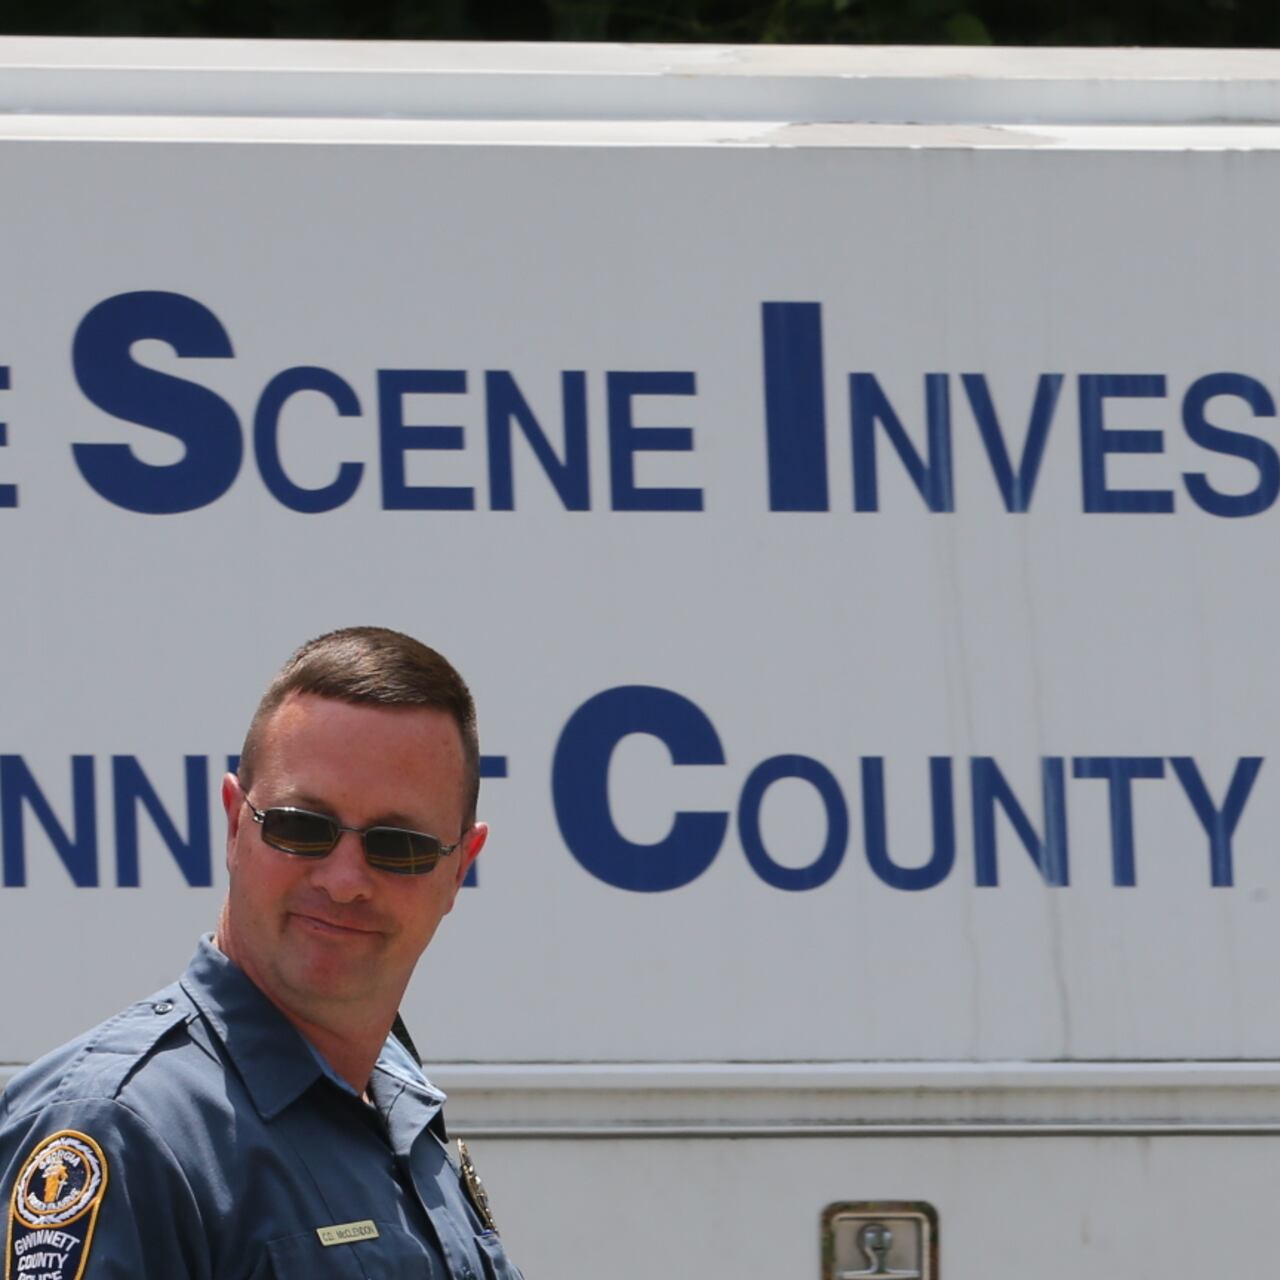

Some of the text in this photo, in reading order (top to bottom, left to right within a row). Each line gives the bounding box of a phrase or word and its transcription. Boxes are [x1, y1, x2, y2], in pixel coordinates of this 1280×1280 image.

[70, 290, 706, 515] SCENE
[550, 684, 1265, 893] COUNTY
[14, 1229, 80, 1256] GWINNETT
[17, 1251, 69, 1272] COUNTY
